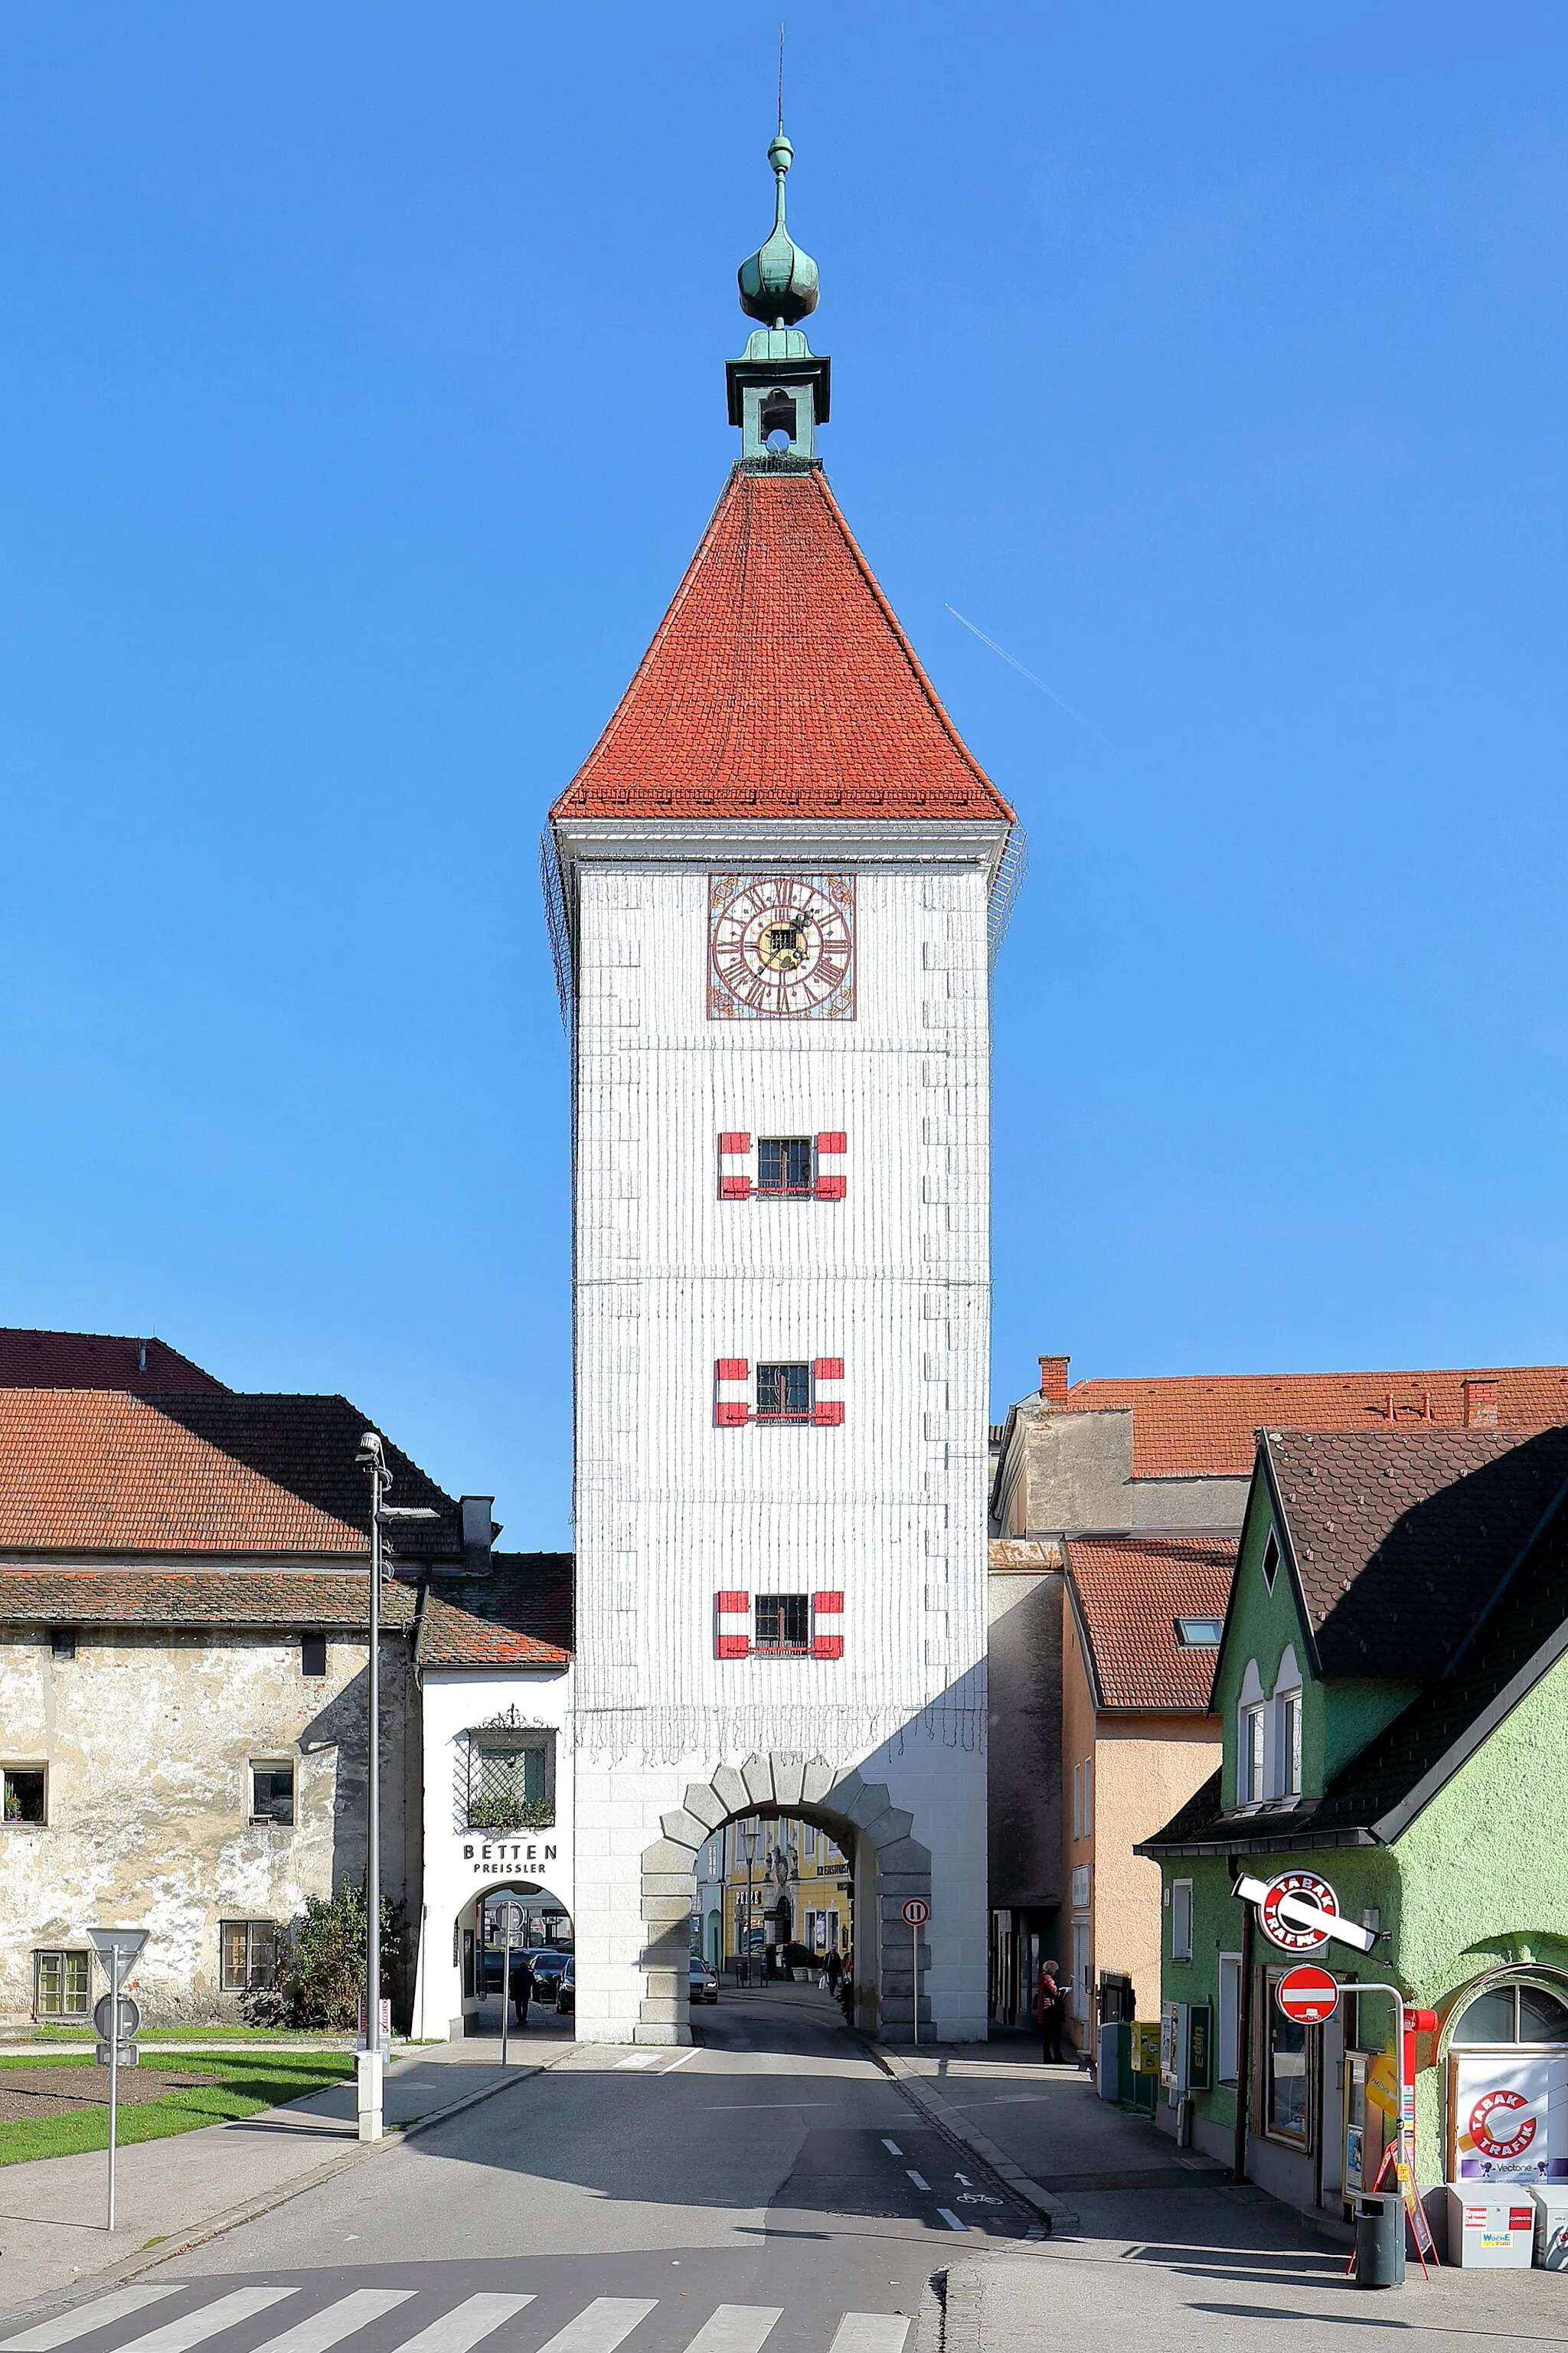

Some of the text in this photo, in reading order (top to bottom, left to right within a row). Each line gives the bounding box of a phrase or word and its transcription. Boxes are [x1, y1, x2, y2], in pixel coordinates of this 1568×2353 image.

[463, 1845, 557, 1860] BETTEN
[474, 1864, 546, 1873] PREISSLER
[1276, 1877, 1334, 1909] TABAK
[1266, 1904, 1319, 1946] TRAFIK
[1472, 2093, 1519, 2131] TABAK
[1479, 2125, 1534, 2155] TRAFIK
[1497, 2163, 1532, 2172] Vectone
